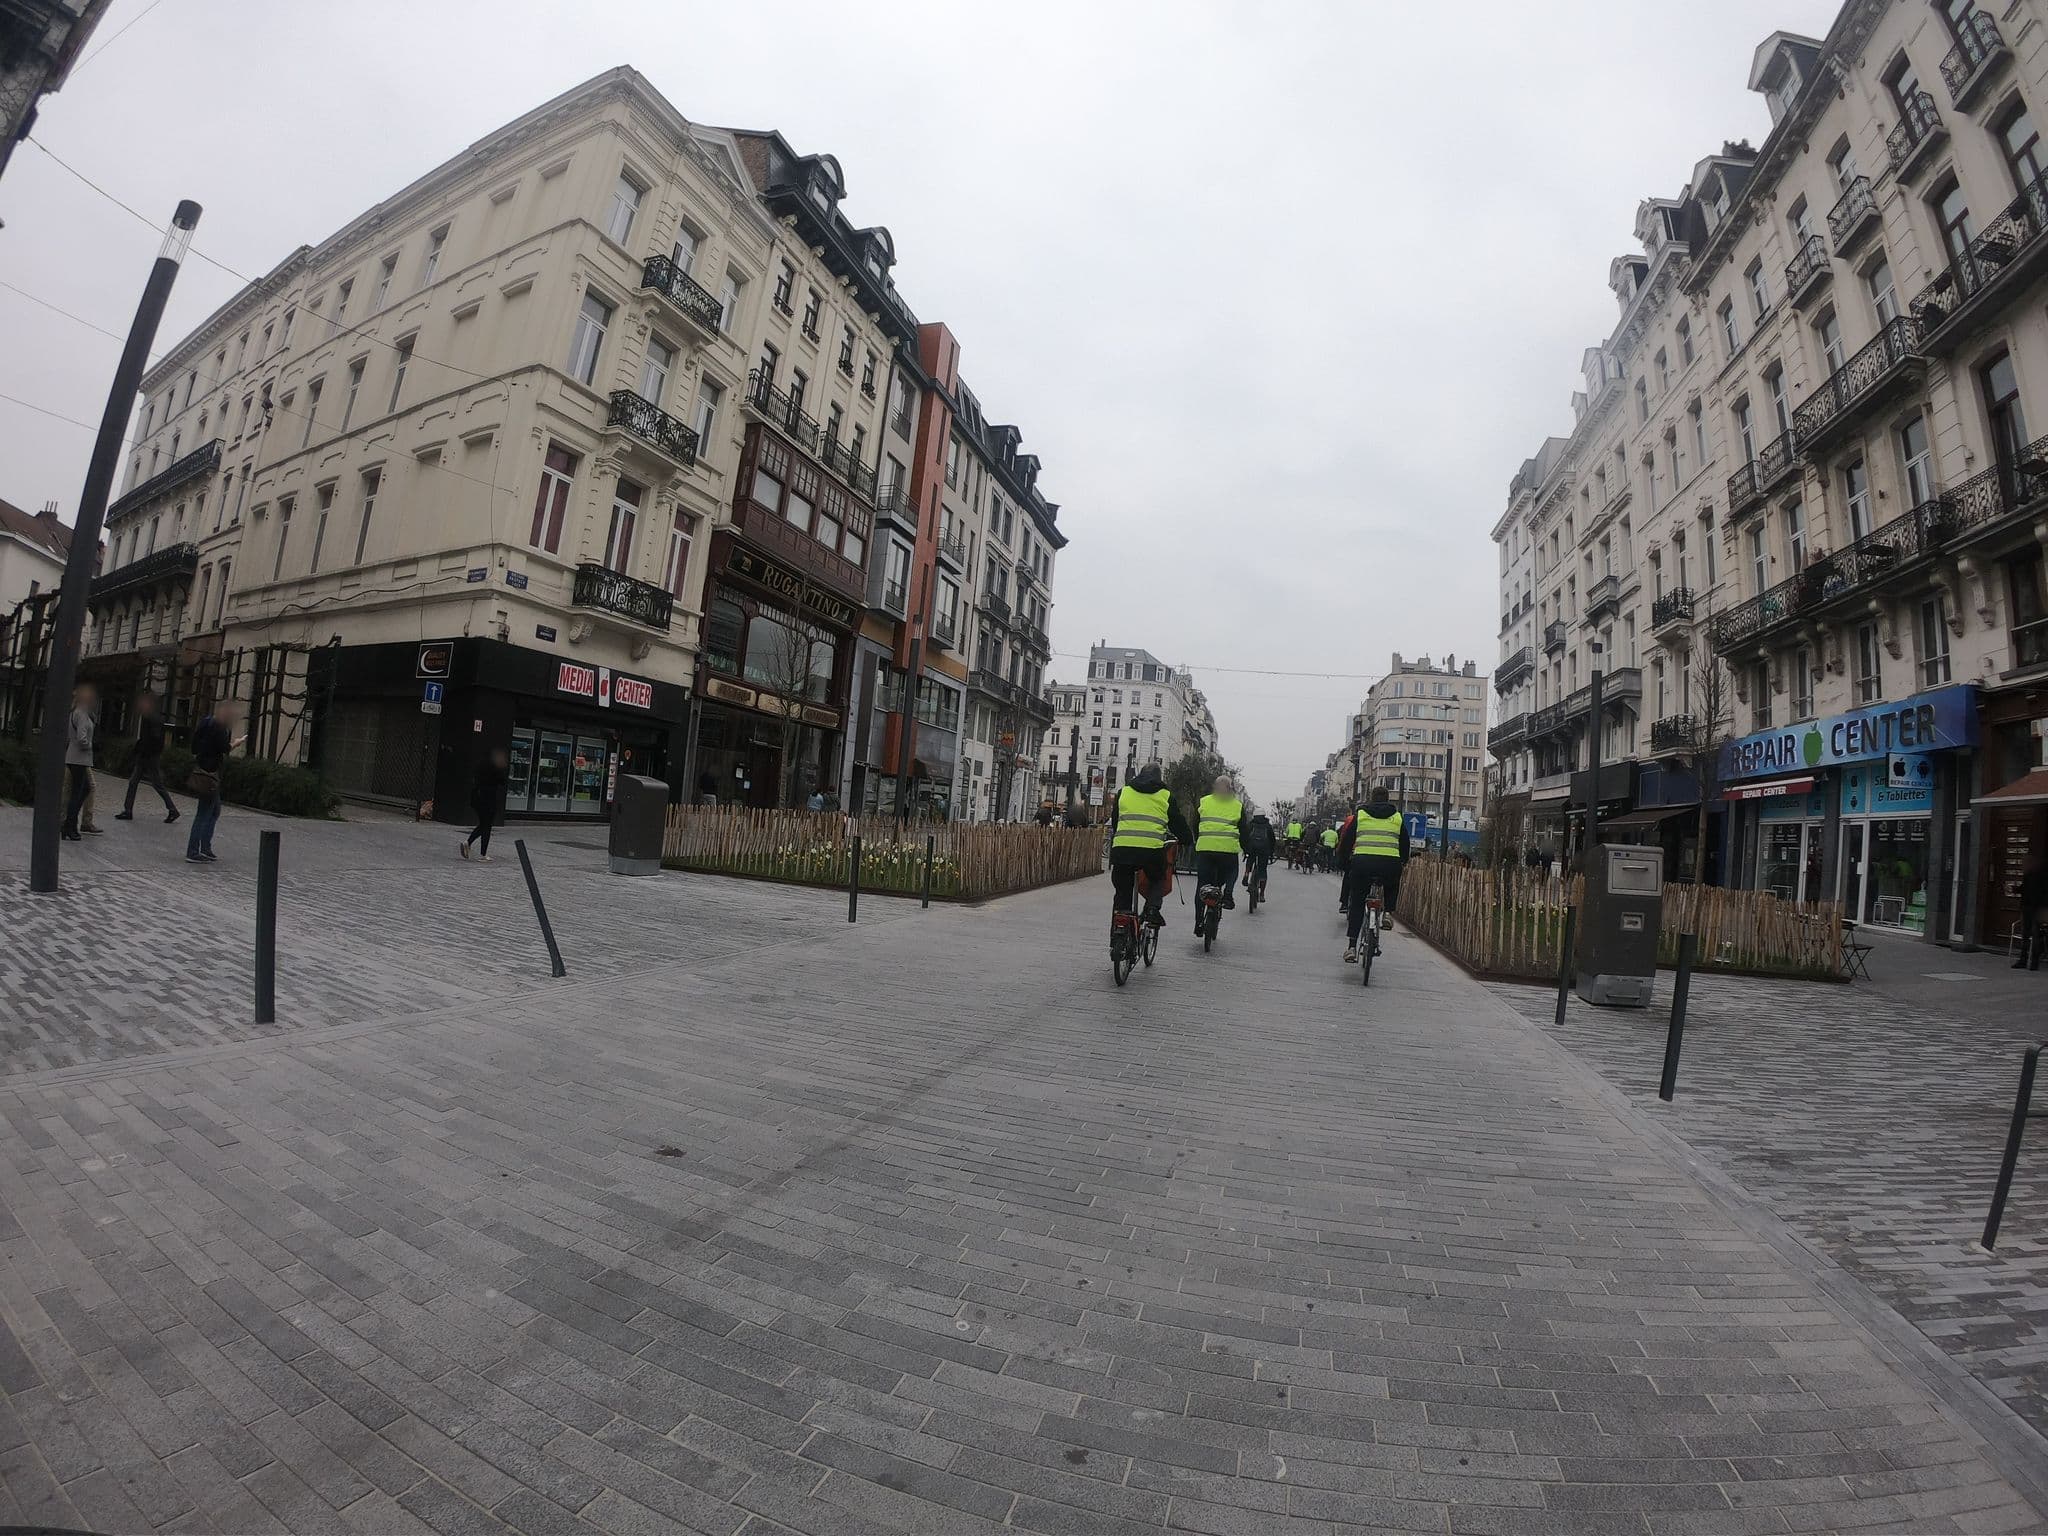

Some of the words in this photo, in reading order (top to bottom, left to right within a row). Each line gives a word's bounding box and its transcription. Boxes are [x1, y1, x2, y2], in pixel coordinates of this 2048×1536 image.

[762, 564, 841, 619] RUGANTINO
[558, 664, 595, 696] MEDIA
[615, 677, 652, 708] CENTER
[1731, 733, 1797, 772] REPAIR
[1831, 703, 1937, 757] CENTER
[1742, 789, 1762, 799] REPAIR
[1763, 786, 1787, 797] CENTER
[1886, 789, 1927, 801] Tablettes
